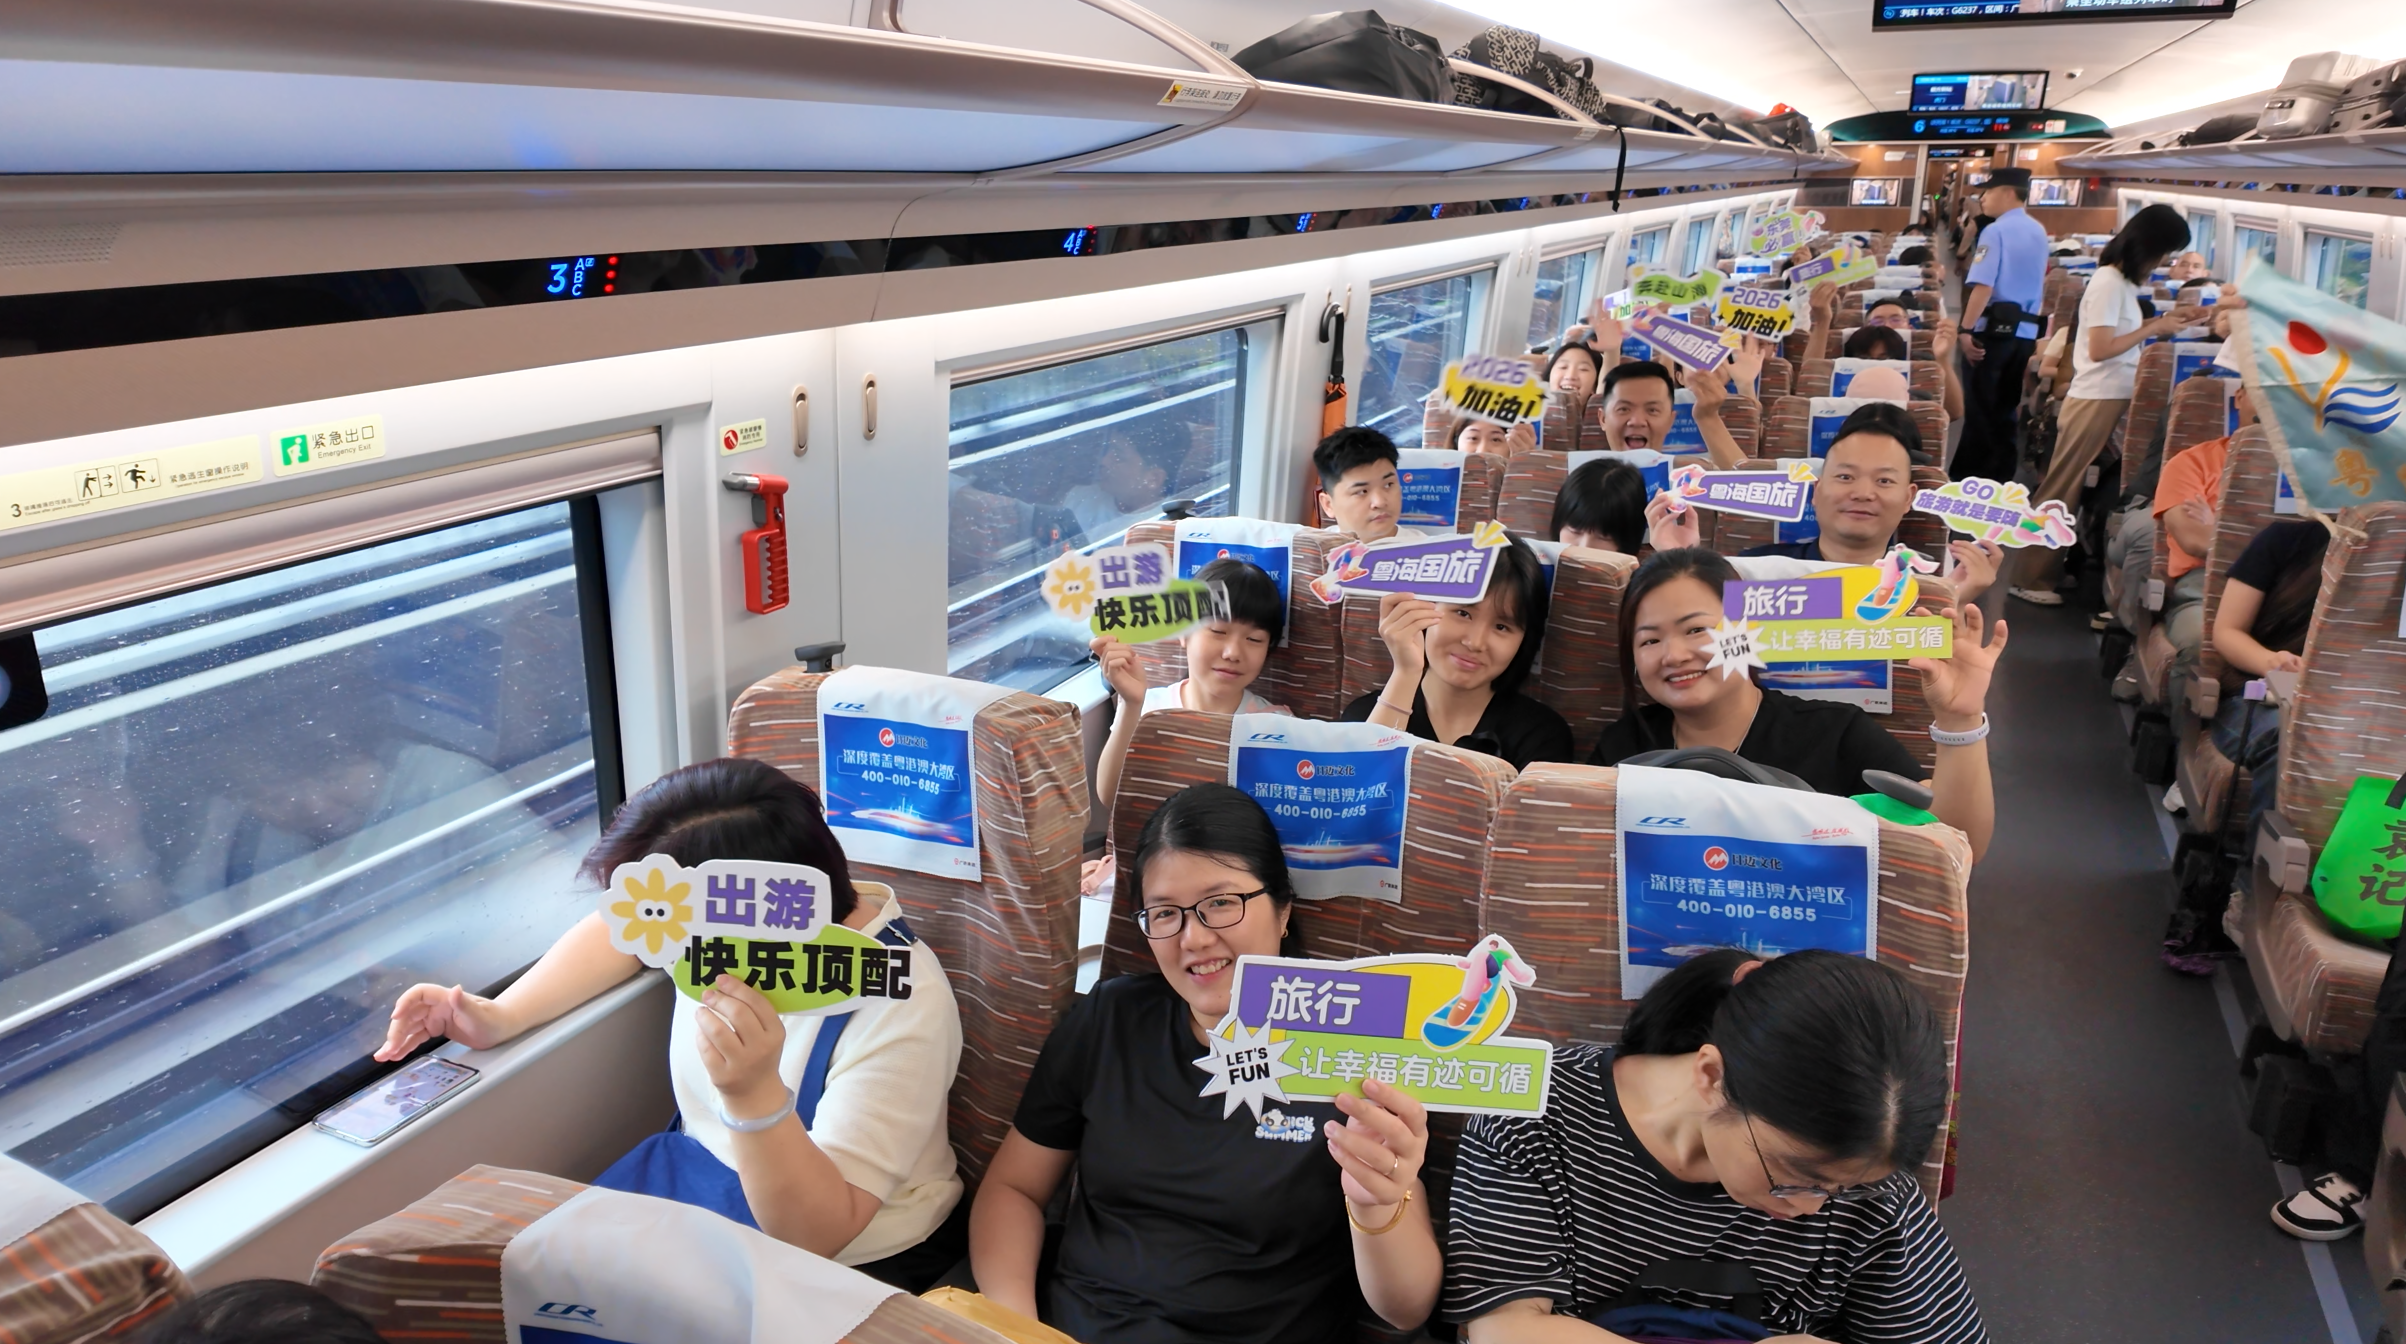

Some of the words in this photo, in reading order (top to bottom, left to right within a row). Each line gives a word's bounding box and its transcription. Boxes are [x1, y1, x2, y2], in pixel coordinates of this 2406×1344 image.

[1914, 120, 1925, 133] 6
[1064, 232, 1075, 252] 4
[574, 258, 585, 270] A
[547, 263, 568, 293] 3
[574, 271, 583, 283] B
[572, 284, 582, 296] C
[1731, 287, 1782, 309] 2026
[1461, 356, 1531, 385] 2026
[311, 425, 375, 450] 紧急出口
[317, 446, 357, 459] Emergency
[358, 443, 371, 452] Exit
[1709, 480, 1799, 508] 粤海国旅
[1961, 479, 1995, 500] GO
[10, 503, 22, 518] 3
[1099, 551, 1164, 589] 出游
[1370, 550, 1485, 584] 粤海国旅
[1742, 585, 1809, 617] 旅行
[1719, 634, 1748, 648] LET'S
[1770, 626, 1944, 651] 让幸福有迹可循
[1723, 645, 1751, 659] FUN
[843, 748, 956, 781] 深度覆盖粤港澳大湾区
[861, 769, 940, 795] 400-010-6855
[1254, 781, 1389, 803] 深度覆盖粤港澳大湾区
[1274, 803, 1367, 819] 400-010-6855
[1639, 816, 1687, 826] CR
[1731, 853, 1783, 871] 日迈文化
[1650, 873, 1847, 906] 深度覆盖粤港澳大湾区
[705, 873, 816, 931] 出游
[1676, 899, 1817, 922] 400-010-6855
[684, 935, 912, 1001] 快乐顶配
[1266, 975, 1361, 1026] 旅行
[1225, 1046, 1269, 1067] LET'S
[1228, 1062, 1271, 1086] FUN
[1298, 1047, 1533, 1095] 让幸福有迹可循
[538, 1302, 597, 1321] CR
